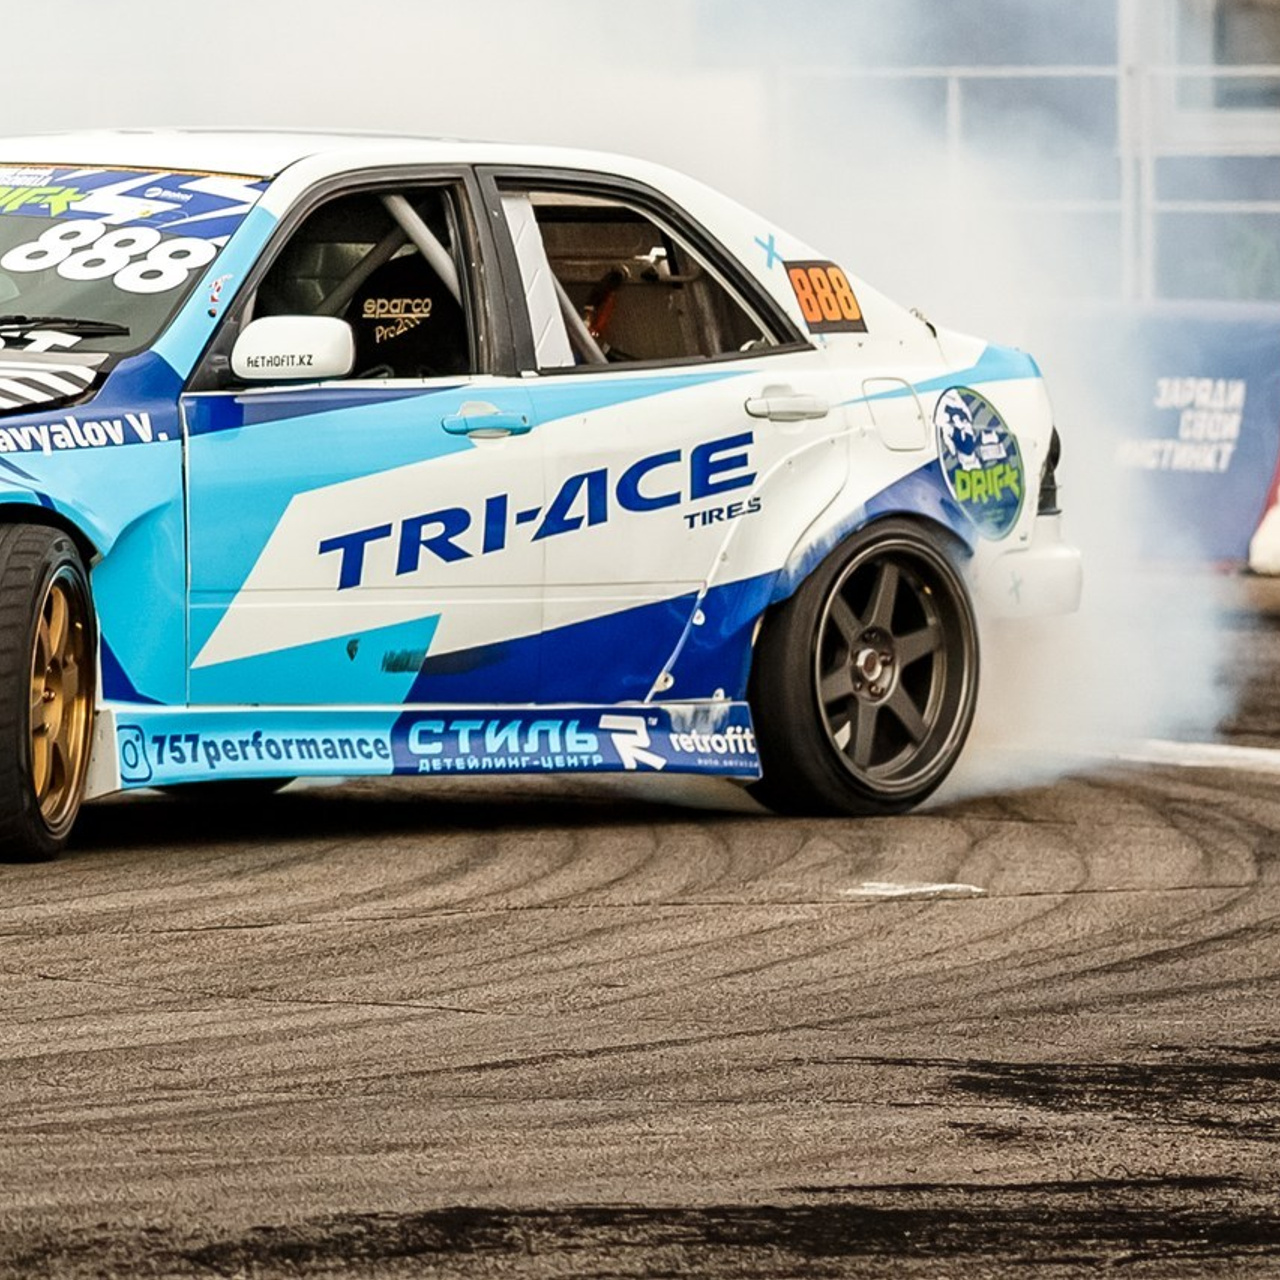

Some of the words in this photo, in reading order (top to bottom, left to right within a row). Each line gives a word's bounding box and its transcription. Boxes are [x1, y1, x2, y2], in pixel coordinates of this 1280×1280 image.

[0, 220, 217, 294] 888
[363, 298, 432, 319] sparco
[788, 267, 862, 323] 888
[124, 412, 169, 443] V.
[955, 463, 1020, 505] DRIFT
[319, 431, 758, 591] TRI-ACE
[683, 497, 762, 530] TIRES
[152, 730, 391, 769] 757performance
[408, 720, 599, 755] СТИЛЬ
[669, 725, 757, 755] retrofit
[418, 753, 603, 773] ДЕТЕЙЛИНГ-ЦЕНТР
